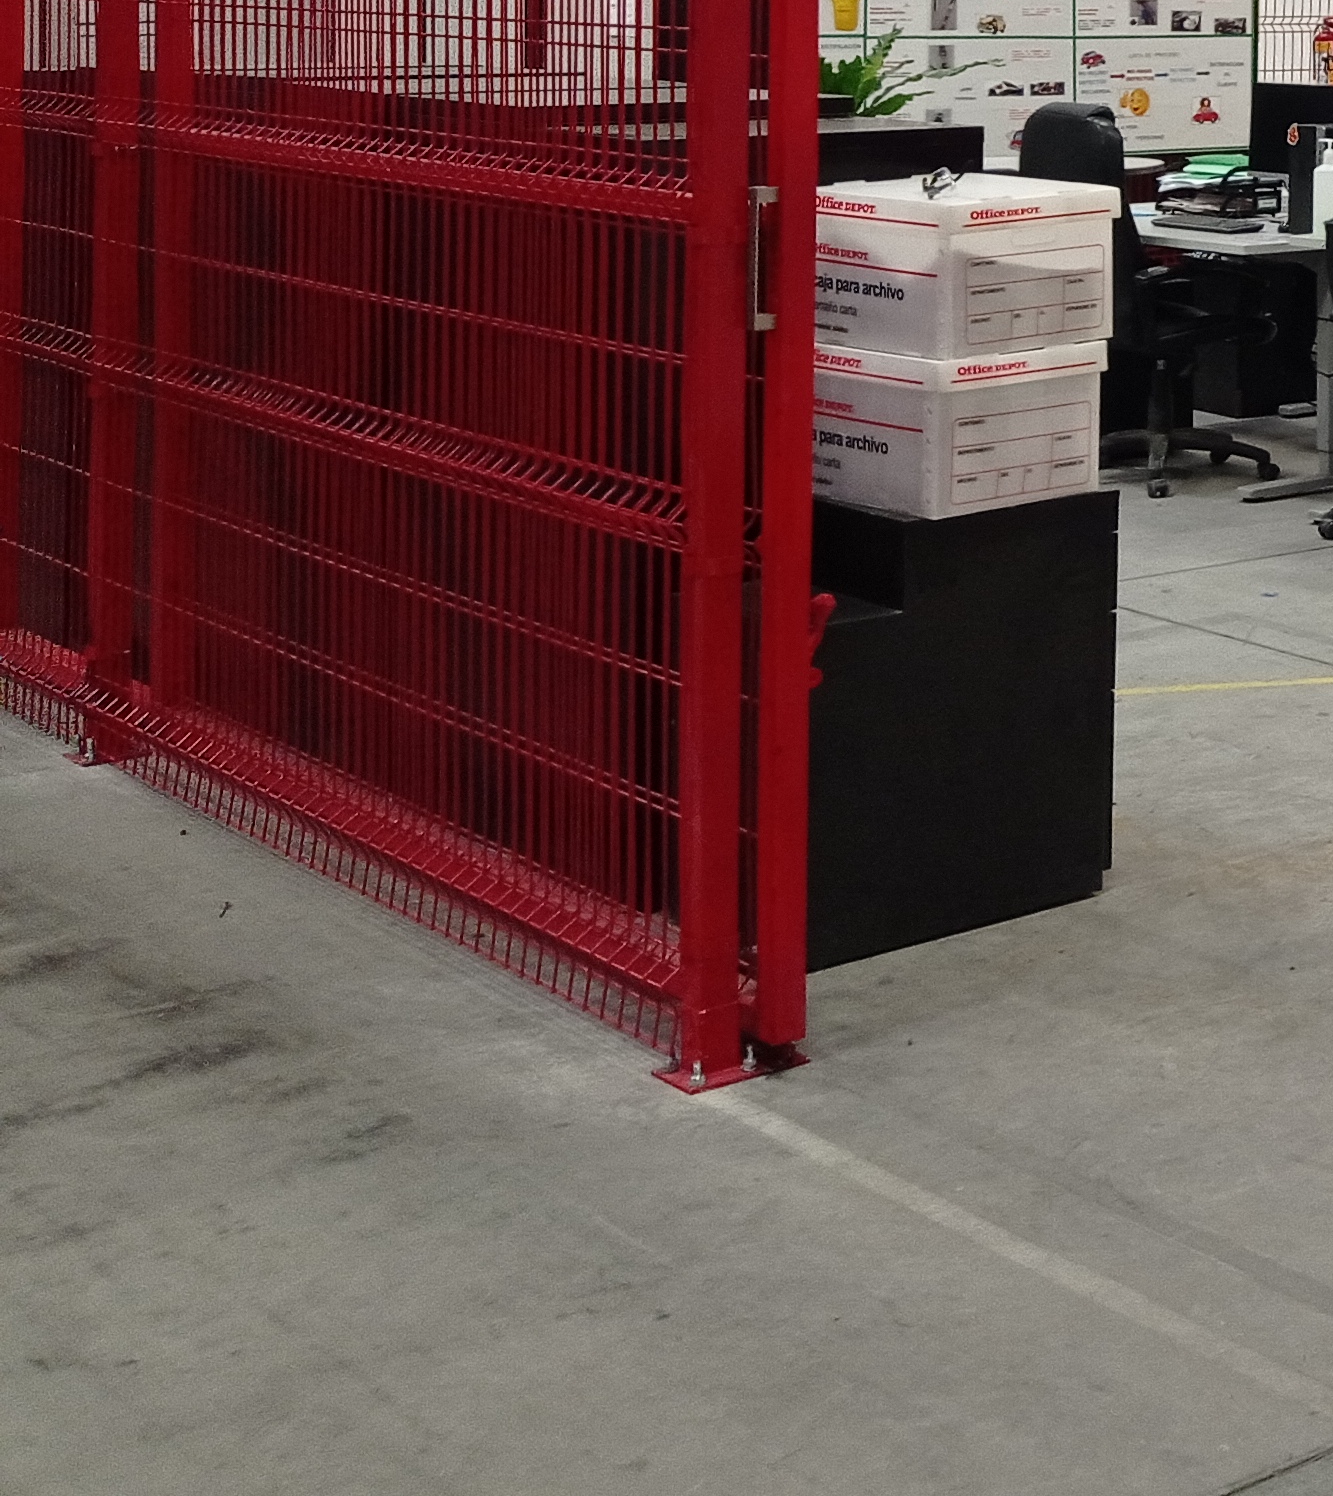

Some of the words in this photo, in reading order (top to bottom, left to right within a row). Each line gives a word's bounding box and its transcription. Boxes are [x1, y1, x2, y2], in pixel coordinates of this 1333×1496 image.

[815, 195, 843, 210] Office
[845, 202, 876, 214] DEPOT
[970, 208, 1006, 220] Office
[1007, 207, 1041, 217] DEPOT
[815, 243, 839, 257] ffice
[841, 249, 868, 261] DEPOT
[835, 278, 860, 294] para
[862, 281, 905, 301] archivo
[830, 356, 861, 368] DEPOT
[957, 365, 993, 376] Office
[995, 361, 1027, 371] DEPOT
[819, 430, 843, 446] para
[845, 435, 889, 454] archivo
